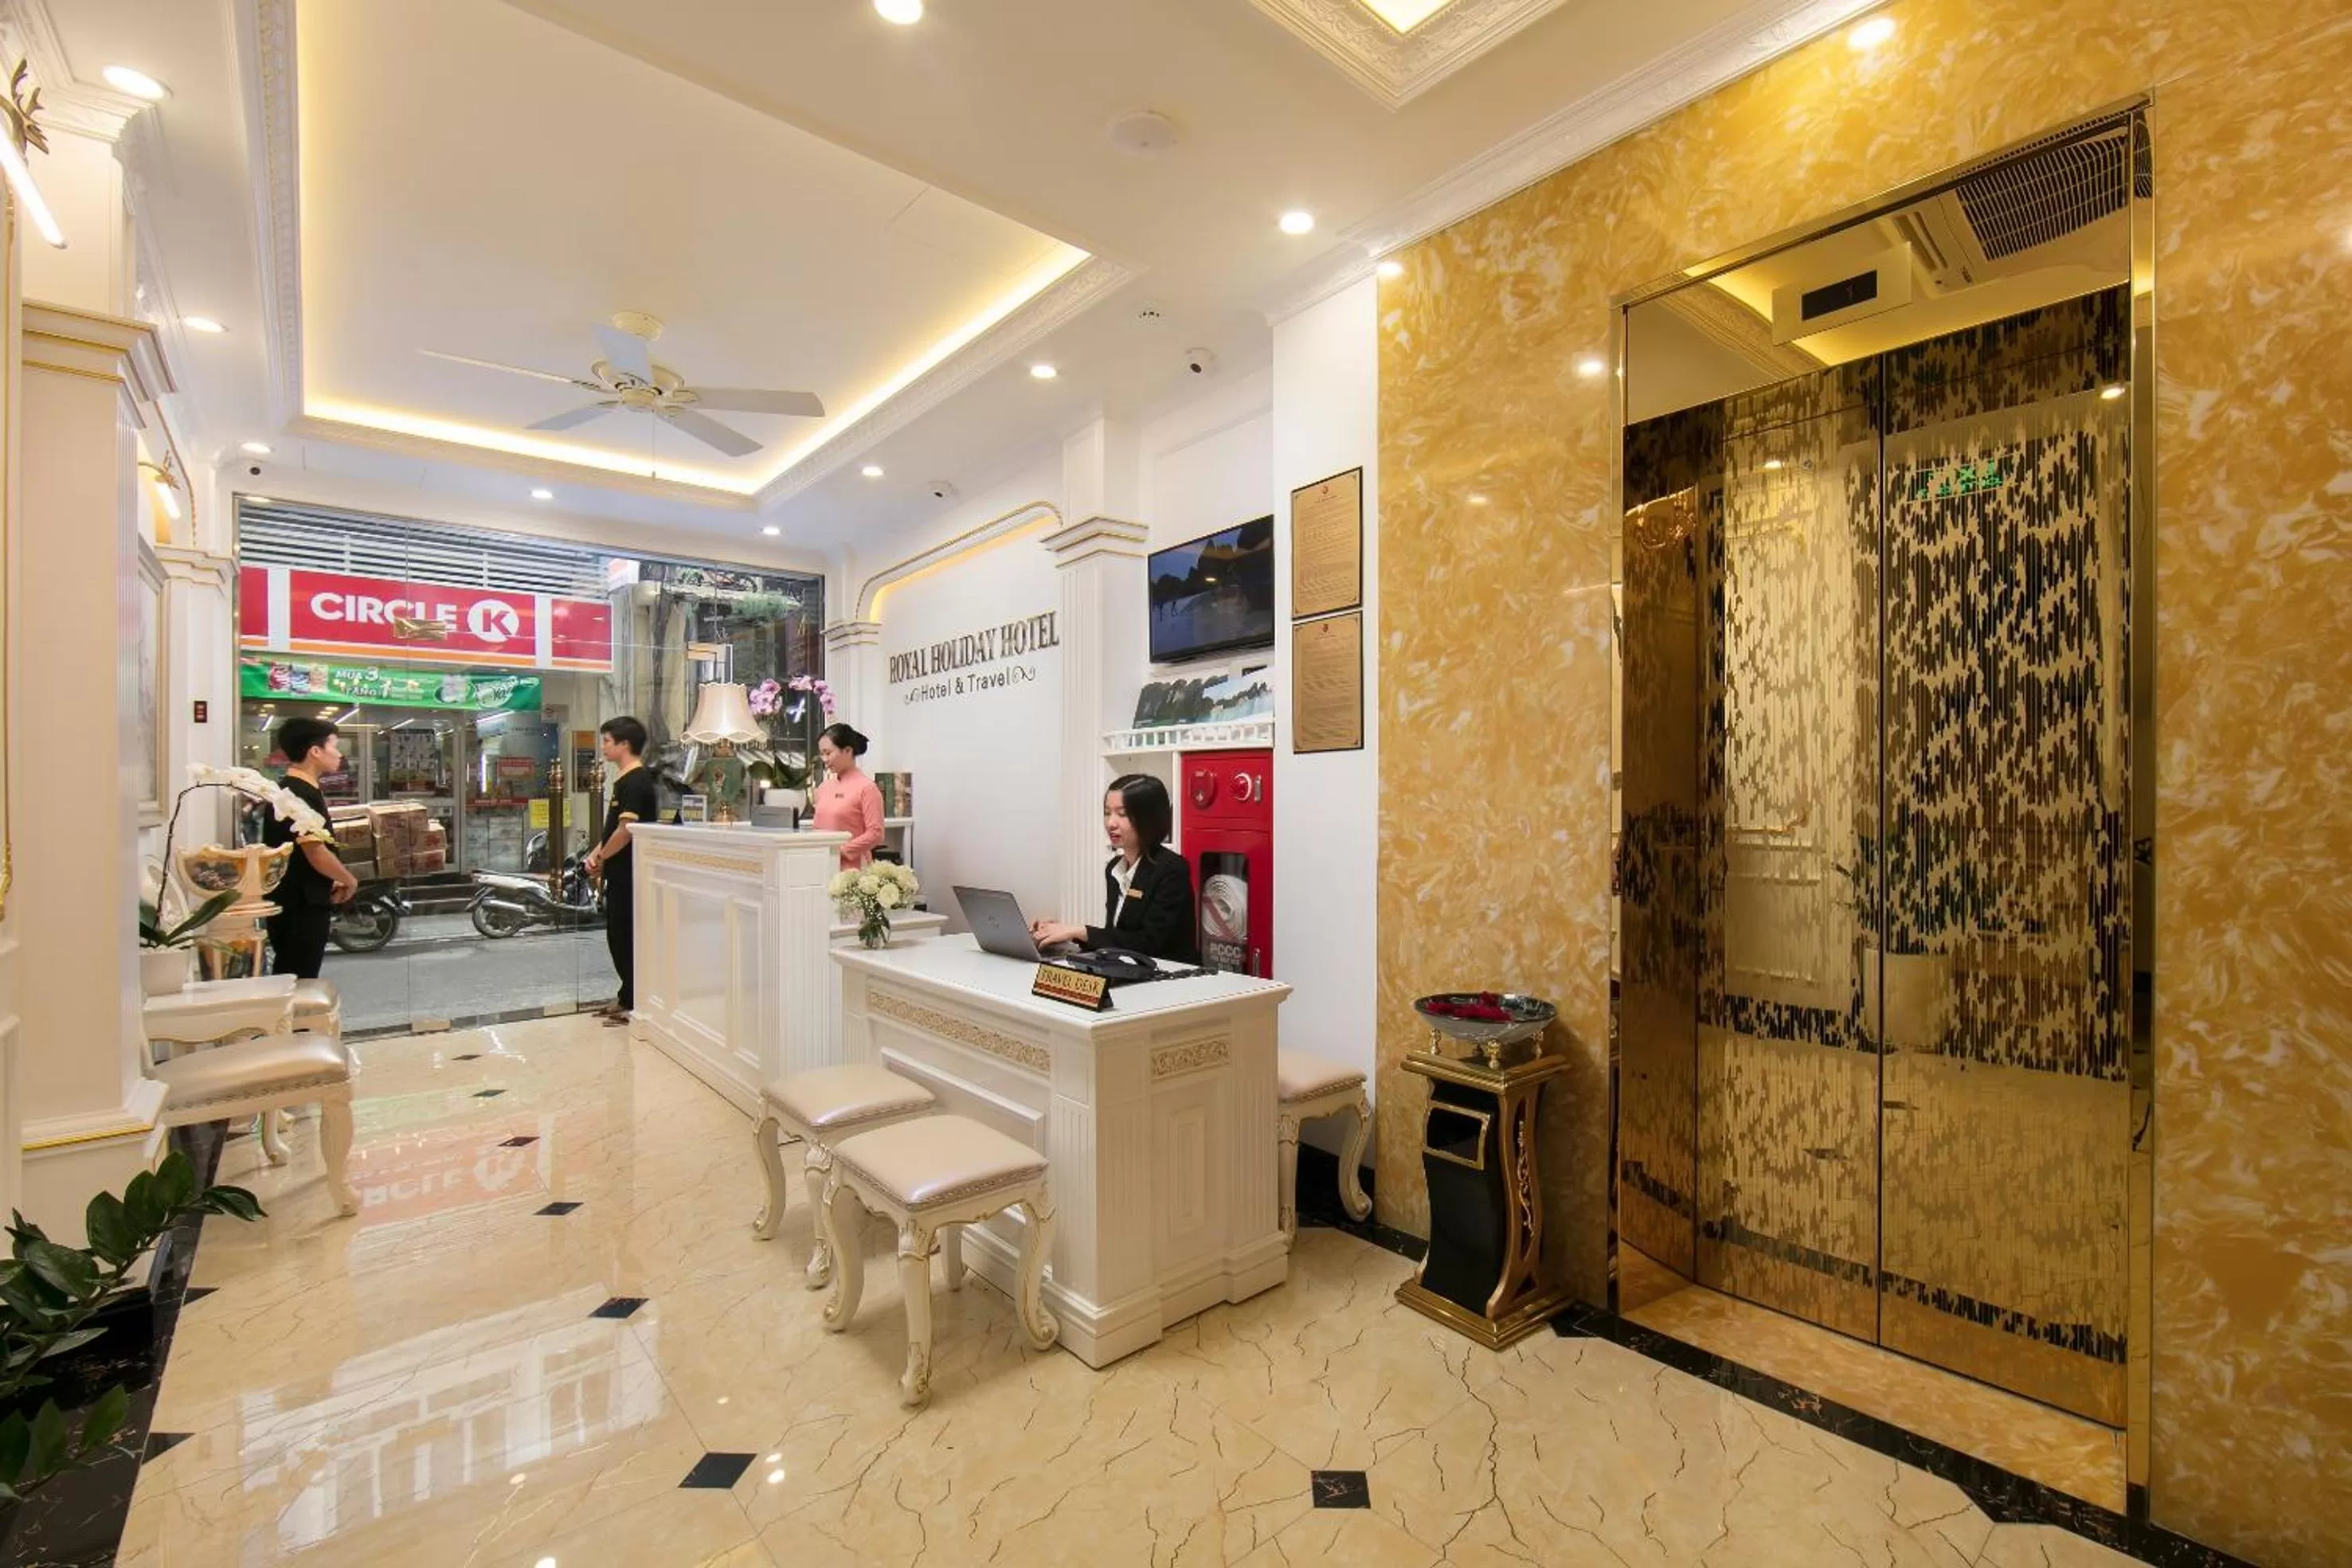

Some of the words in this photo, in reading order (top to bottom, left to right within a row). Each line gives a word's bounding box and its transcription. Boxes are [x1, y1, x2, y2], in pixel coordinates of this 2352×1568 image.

[889, 648, 928, 684] ROYAL
[930, 628, 996, 675] HOLIDAY
[1000, 610, 1060, 658] HOTEL
[921, 679, 952, 702] Hotel
[955, 677, 965, 694] &
[967, 666, 1011, 693] Travel
